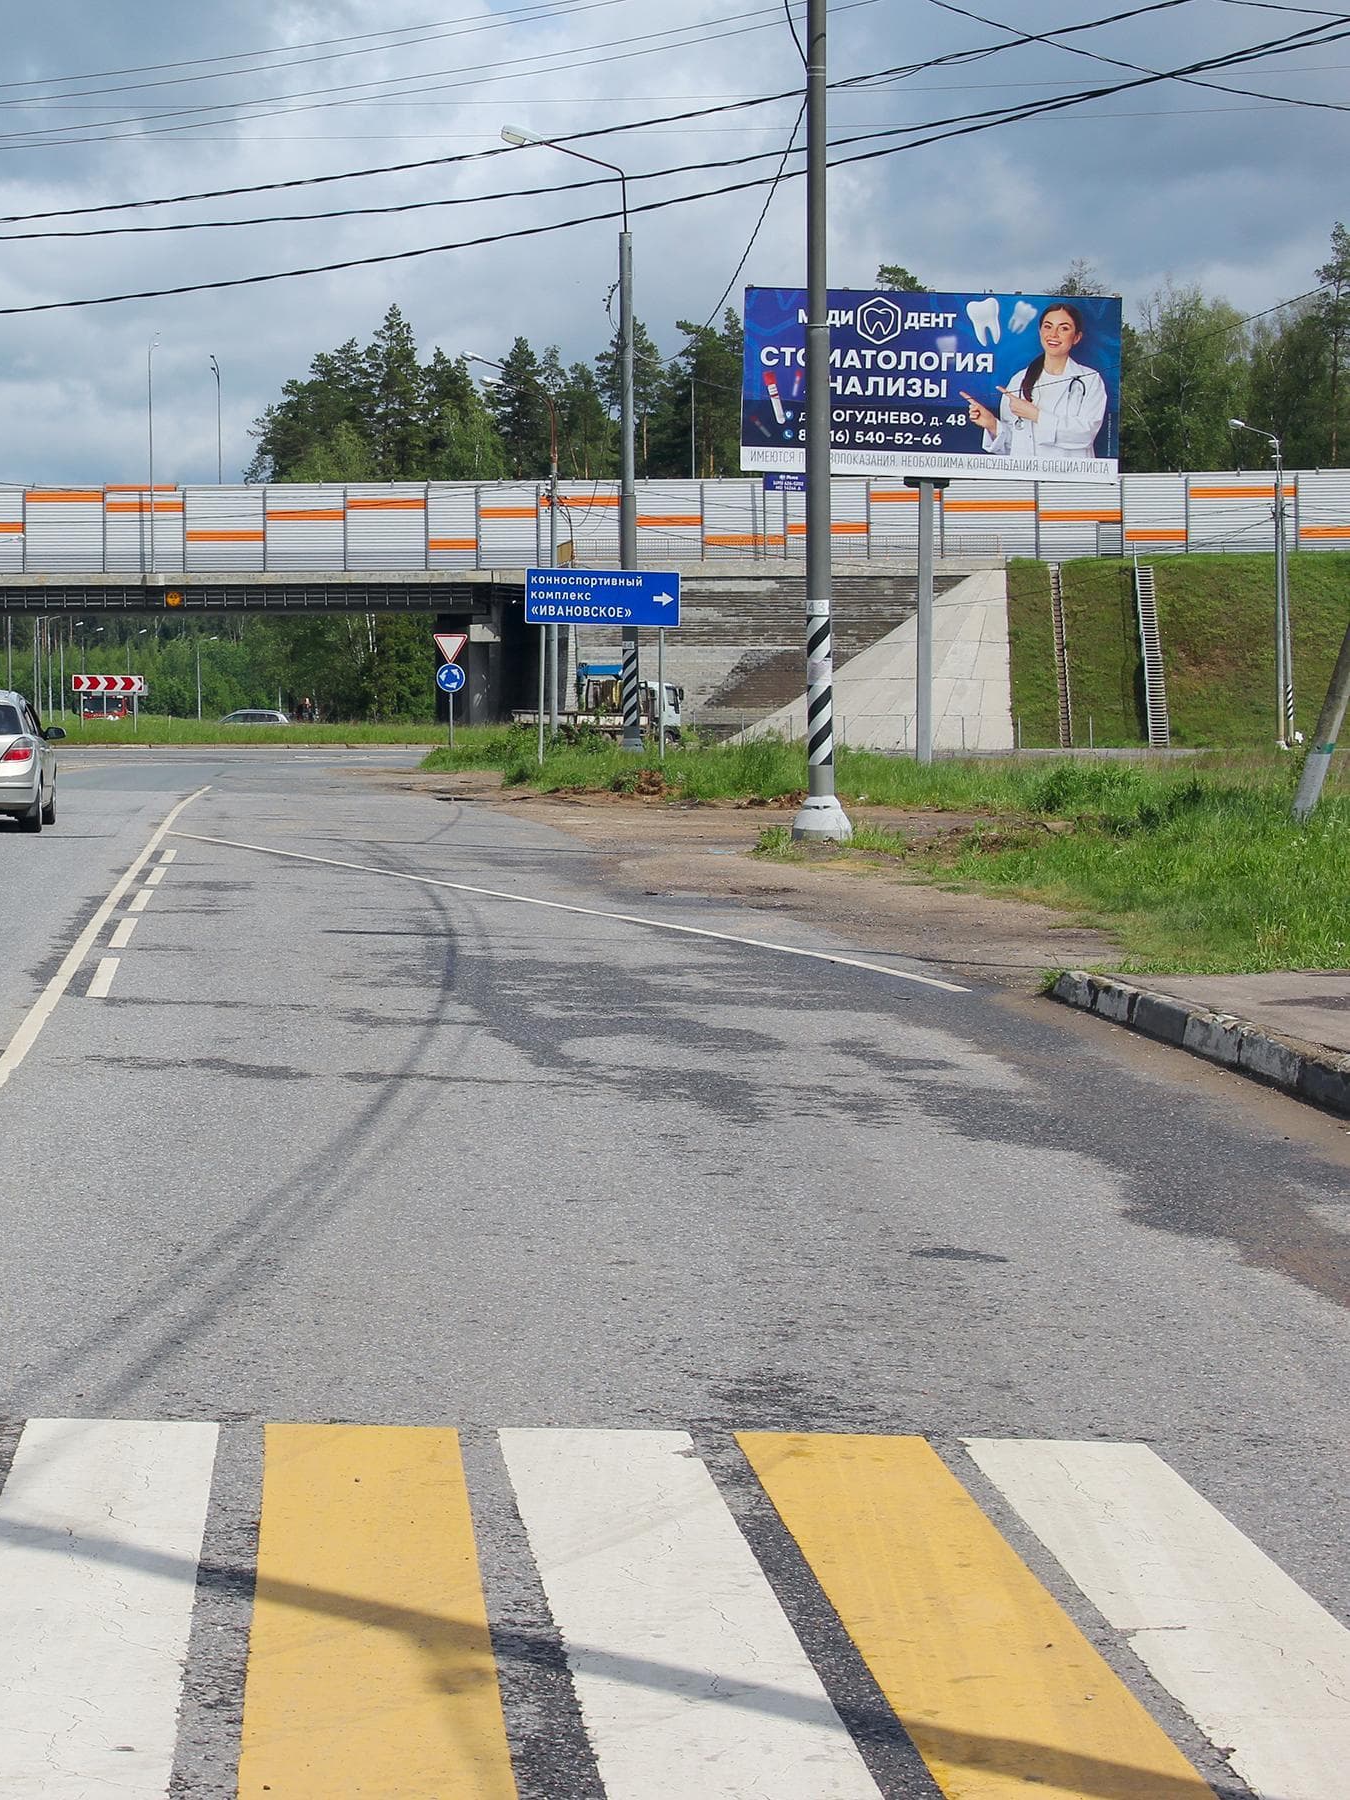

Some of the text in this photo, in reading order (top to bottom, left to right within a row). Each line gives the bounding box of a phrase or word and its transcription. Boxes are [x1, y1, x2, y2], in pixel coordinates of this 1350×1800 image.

[797, 309, 957, 329] МДИ ДЕНТ
[803, 375, 947, 398] НАЛИЗЫ
[832, 409, 967, 427] ОГУДНЕВО, д. 48
[854, 430, 942, 446] 540-52-66
[750, 450, 795, 464] ИМЕЮТСЯ
[901, 455, 964, 469] НЕОБХОДИМА
[967, 458, 1039, 472] КОНСУЛЬТАЦИЯ
[1042, 460, 1110, 474] СПЕЦИАЛИСТА
[531, 575, 643, 588] конноспортивный
[530, 590, 592, 601] комплекс
[531, 605, 632, 618] «ИВАНОВСКОЕ»
